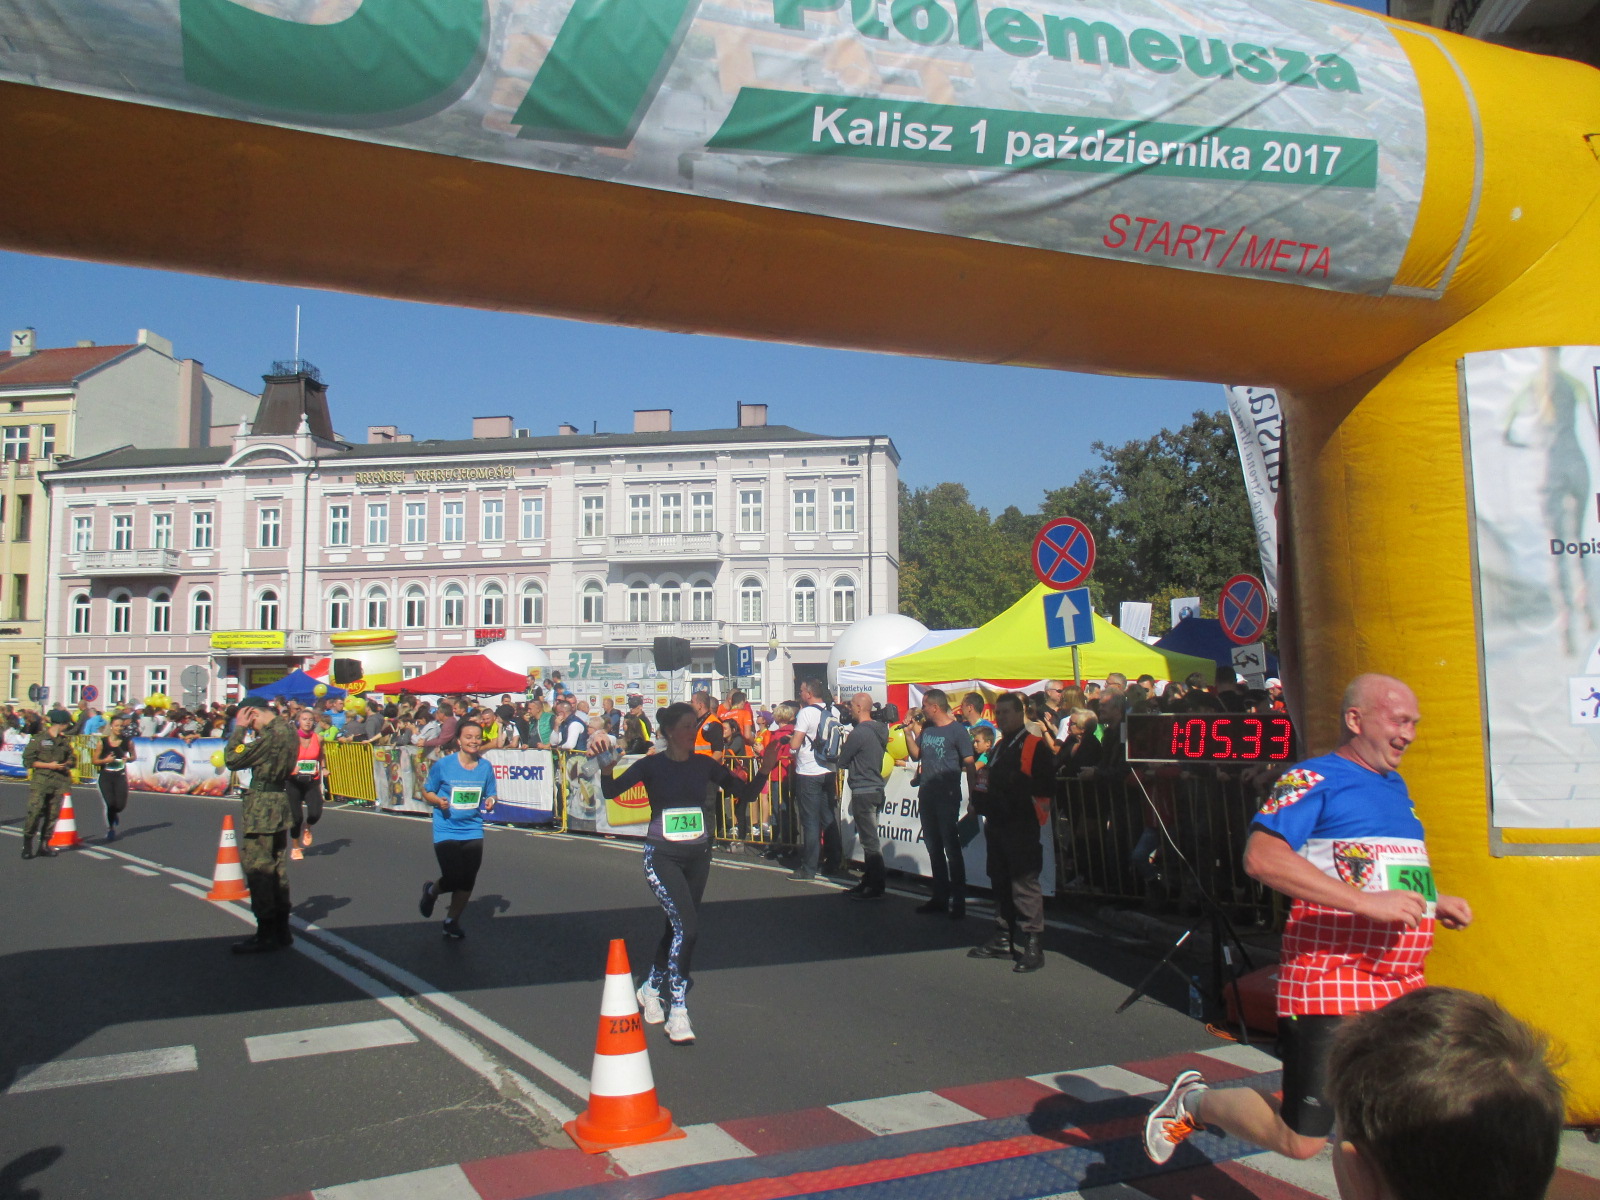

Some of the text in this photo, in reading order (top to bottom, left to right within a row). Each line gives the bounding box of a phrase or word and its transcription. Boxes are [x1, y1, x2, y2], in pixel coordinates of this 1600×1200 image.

[811, 105, 1342, 177] Kalisz 1 października 2017
[1102, 213, 1331, 279] START/META
[475, 628, 506, 638] ERGO
[568, 652, 592, 679] 37
[741, 650, 749, 667] P
[1172, 719, 1290, 759] 1:05.33
[620, 785, 649, 801] WINIA
[901, 798, 919, 818] BM
[672, 816, 697, 830] 734
[1399, 870, 1433, 896] 581
[609, 1018, 641, 1034] ZDM
